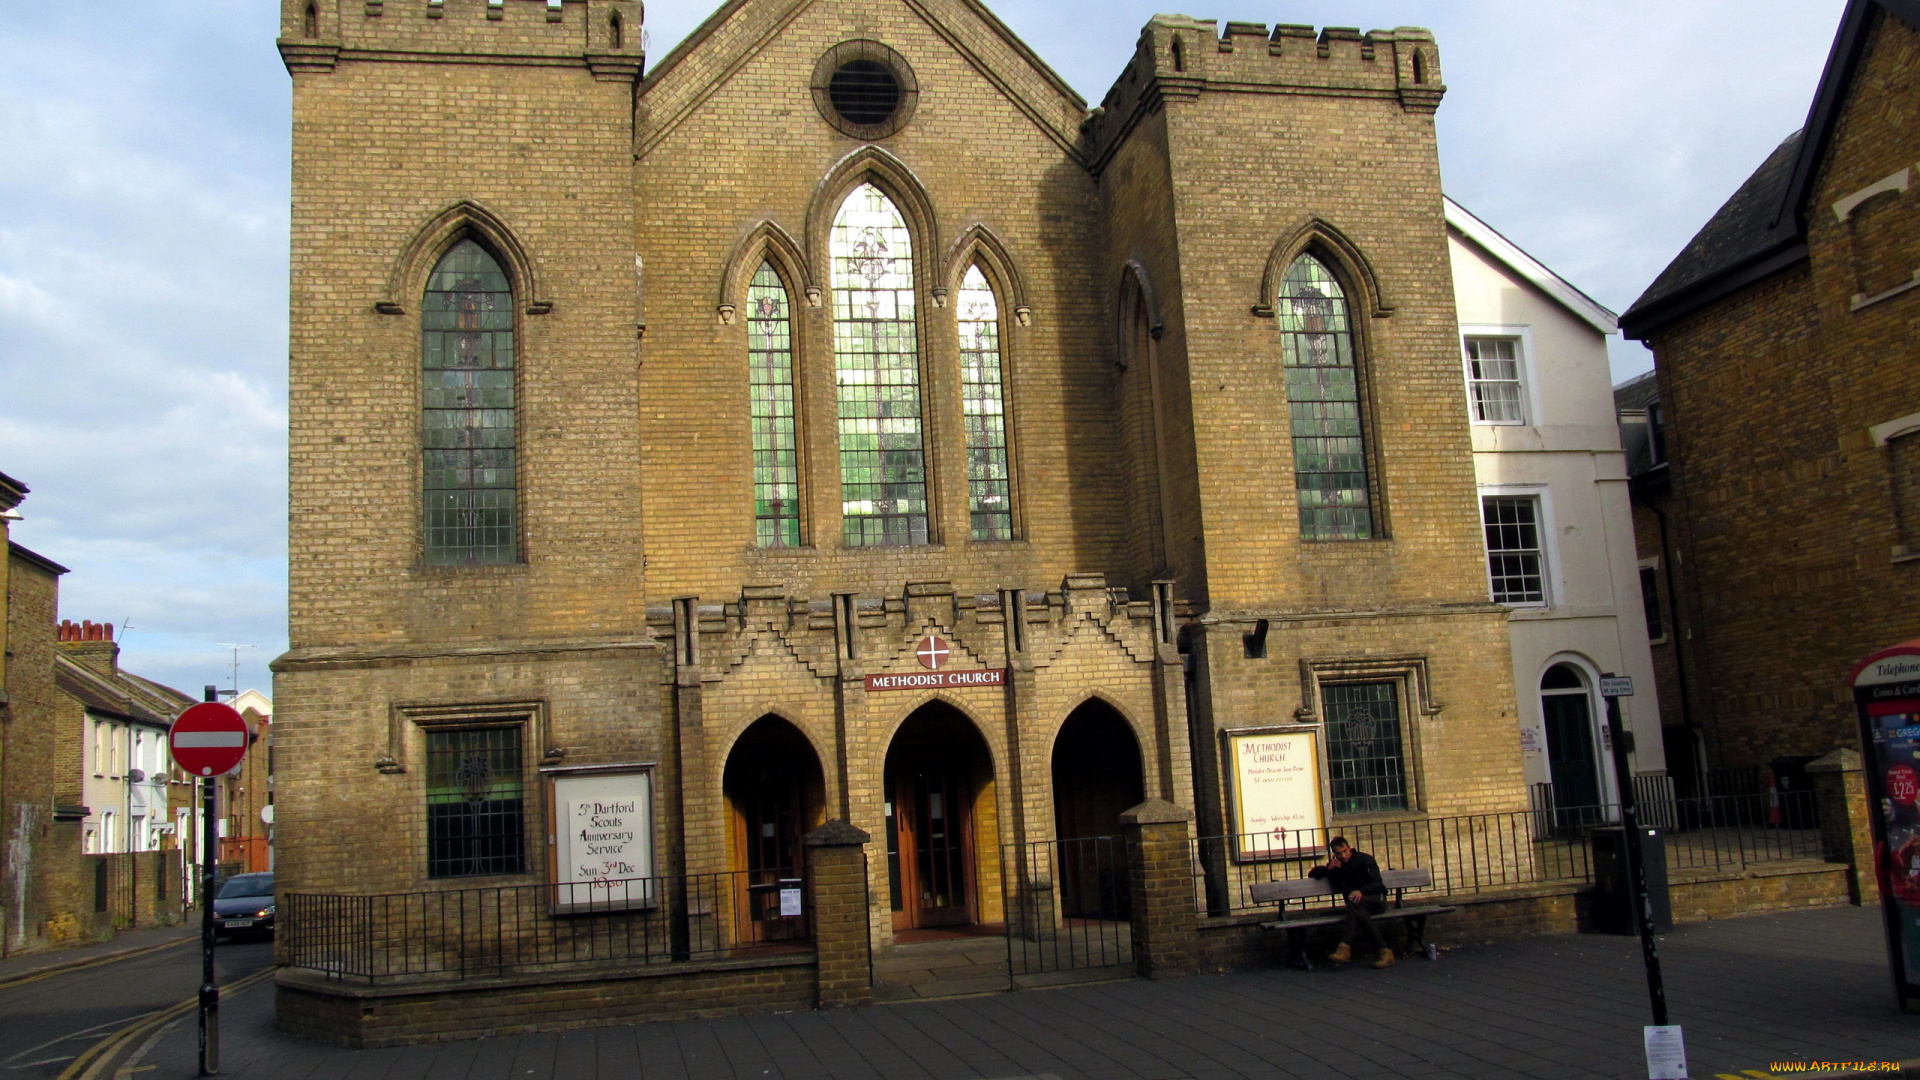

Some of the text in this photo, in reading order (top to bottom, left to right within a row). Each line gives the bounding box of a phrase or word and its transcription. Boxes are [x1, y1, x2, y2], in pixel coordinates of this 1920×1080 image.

[872, 672, 1000, 687] METHODIST CHURCH
[1243, 742, 1292, 755] METHODIST
[1253, 753, 1285, 763] CHURCH
[593, 801, 635, 815] Dartford
[590, 815, 623, 828] Scouts
[579, 829, 634, 844] Anniversary
[586, 842, 623, 855] Service
[578, 861, 636, 877] Sun 3rd Dec
